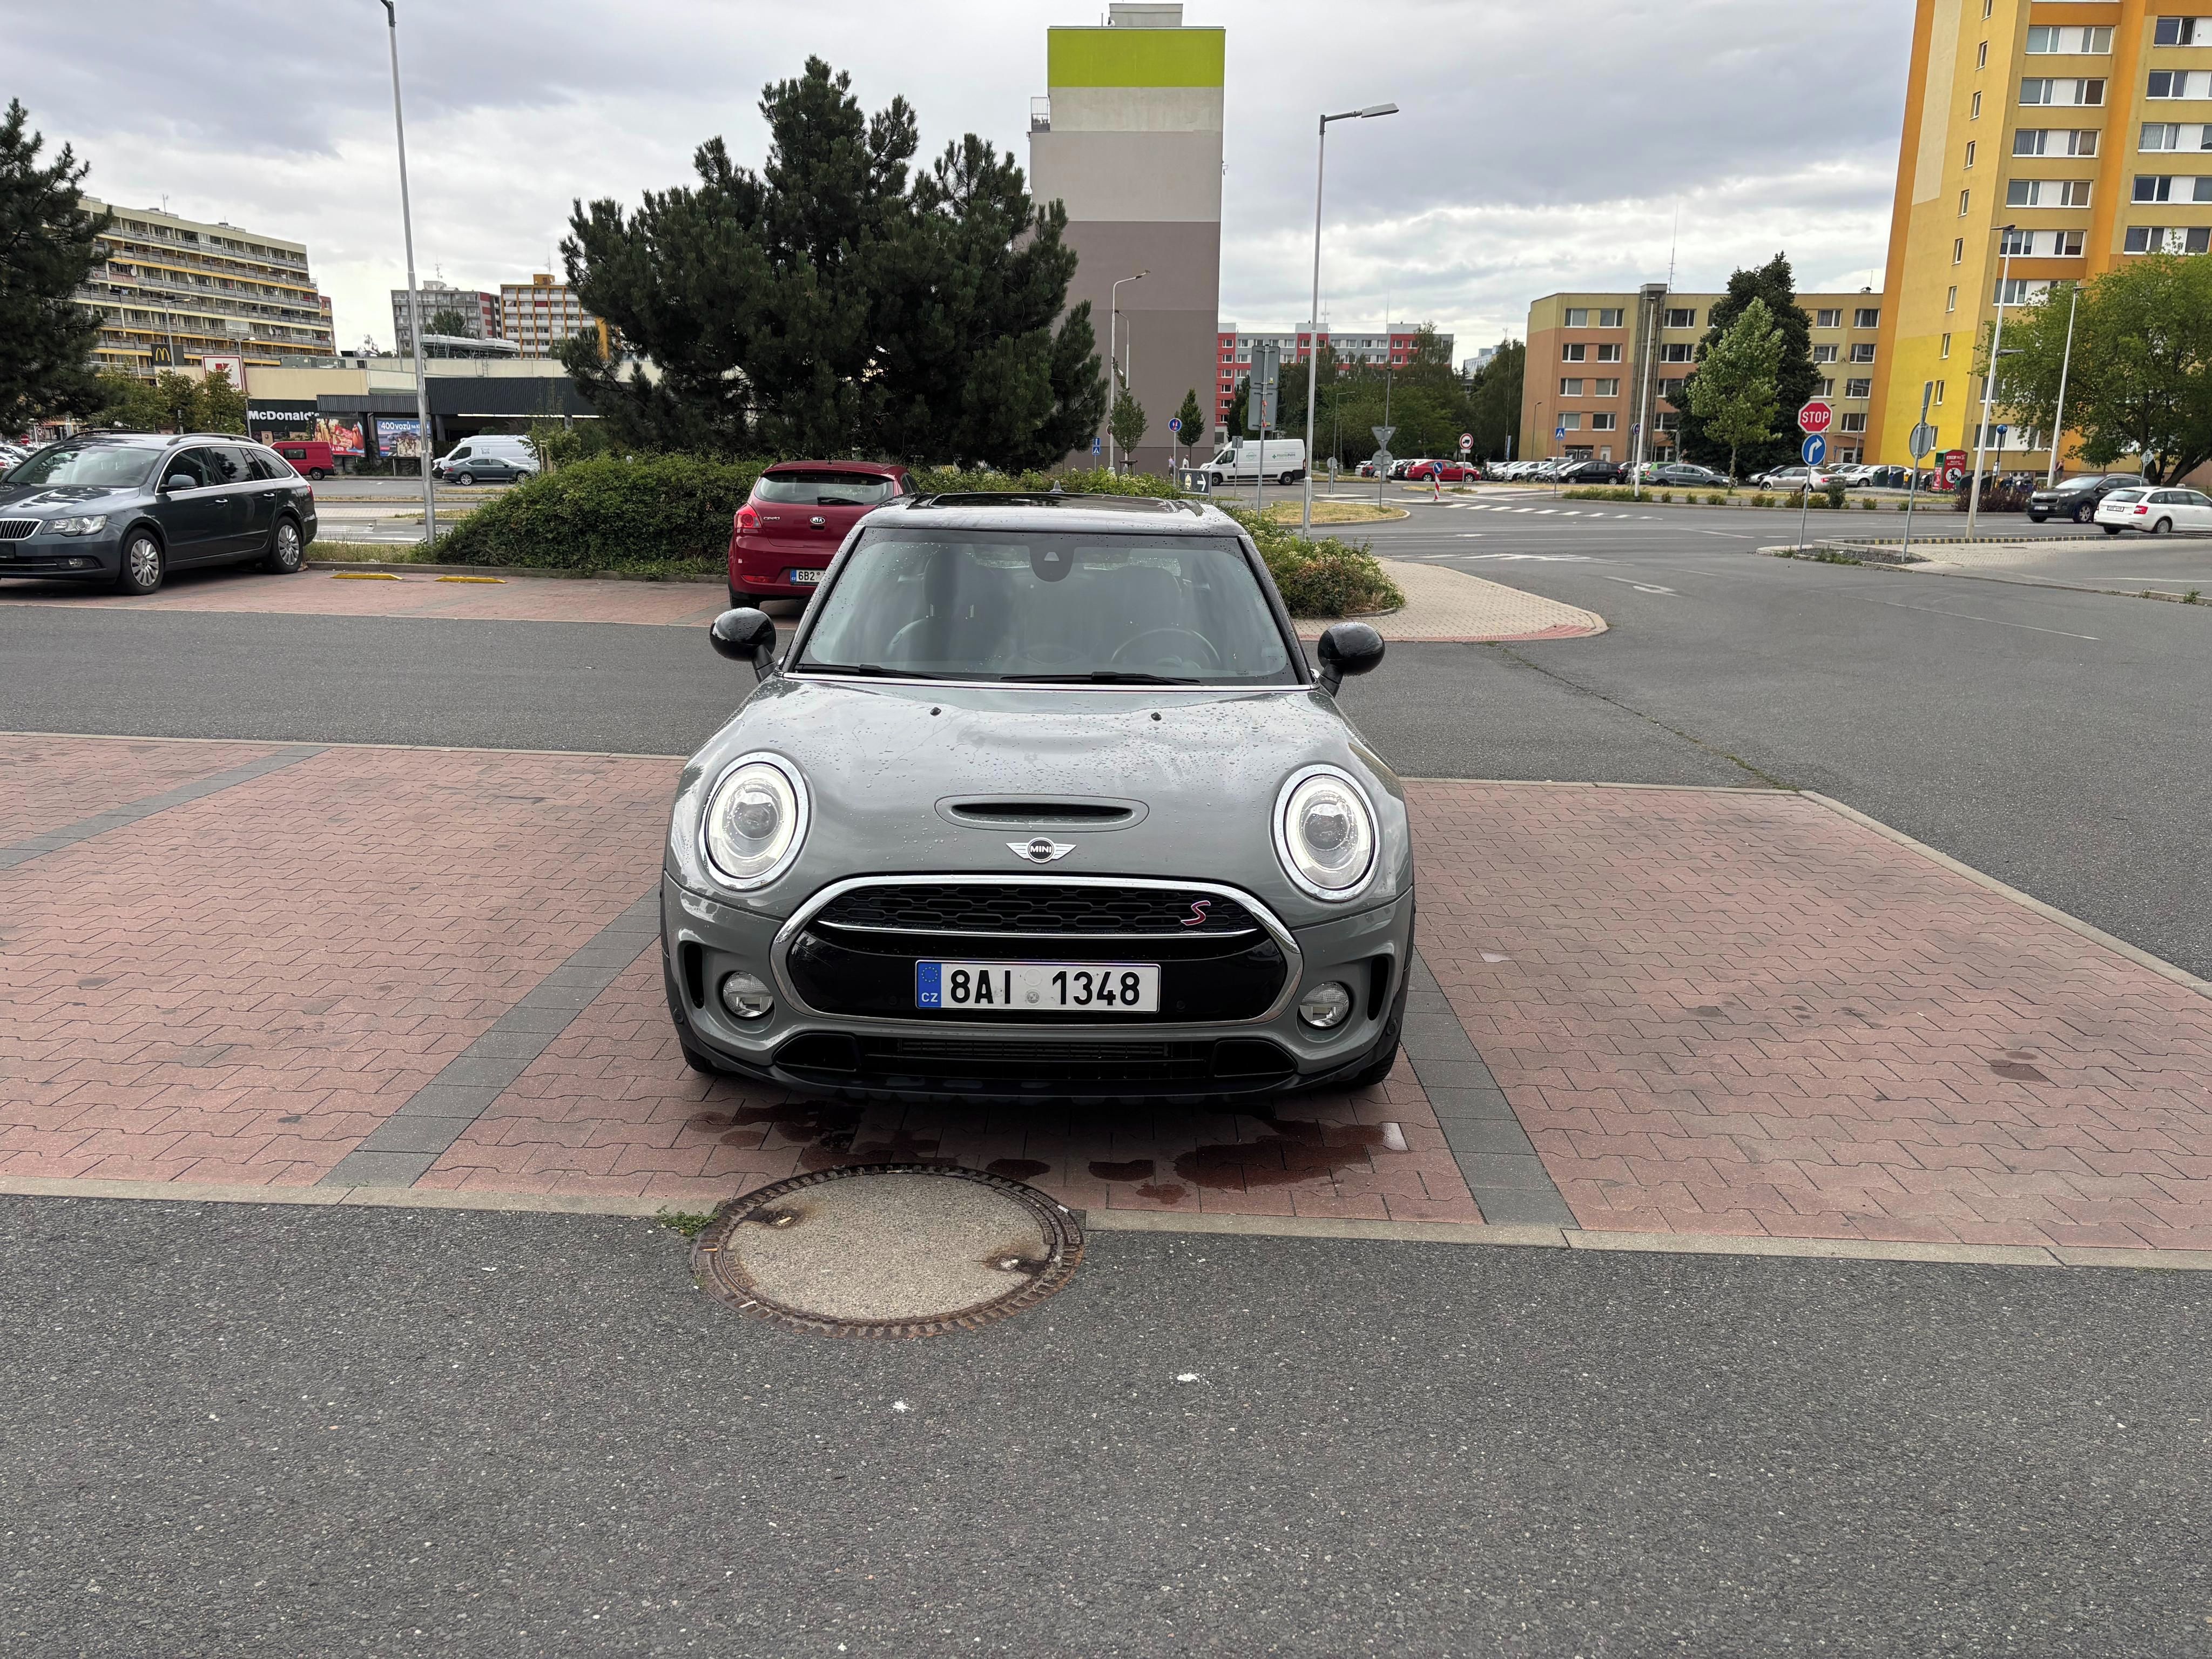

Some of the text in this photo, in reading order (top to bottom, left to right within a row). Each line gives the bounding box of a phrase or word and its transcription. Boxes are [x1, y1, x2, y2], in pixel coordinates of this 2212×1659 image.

[1802, 411, 1829, 423] STOP
[381, 422, 394, 430] 400
[395, 421, 411, 430] vozů
[798, 571, 815, 581] 6B2
[1030, 845, 1052, 853] MINI
[1180, 900, 1211, 926] S
[950, 969, 1140, 1006] 8AI 1348
[921, 992, 938, 1002] CZ
